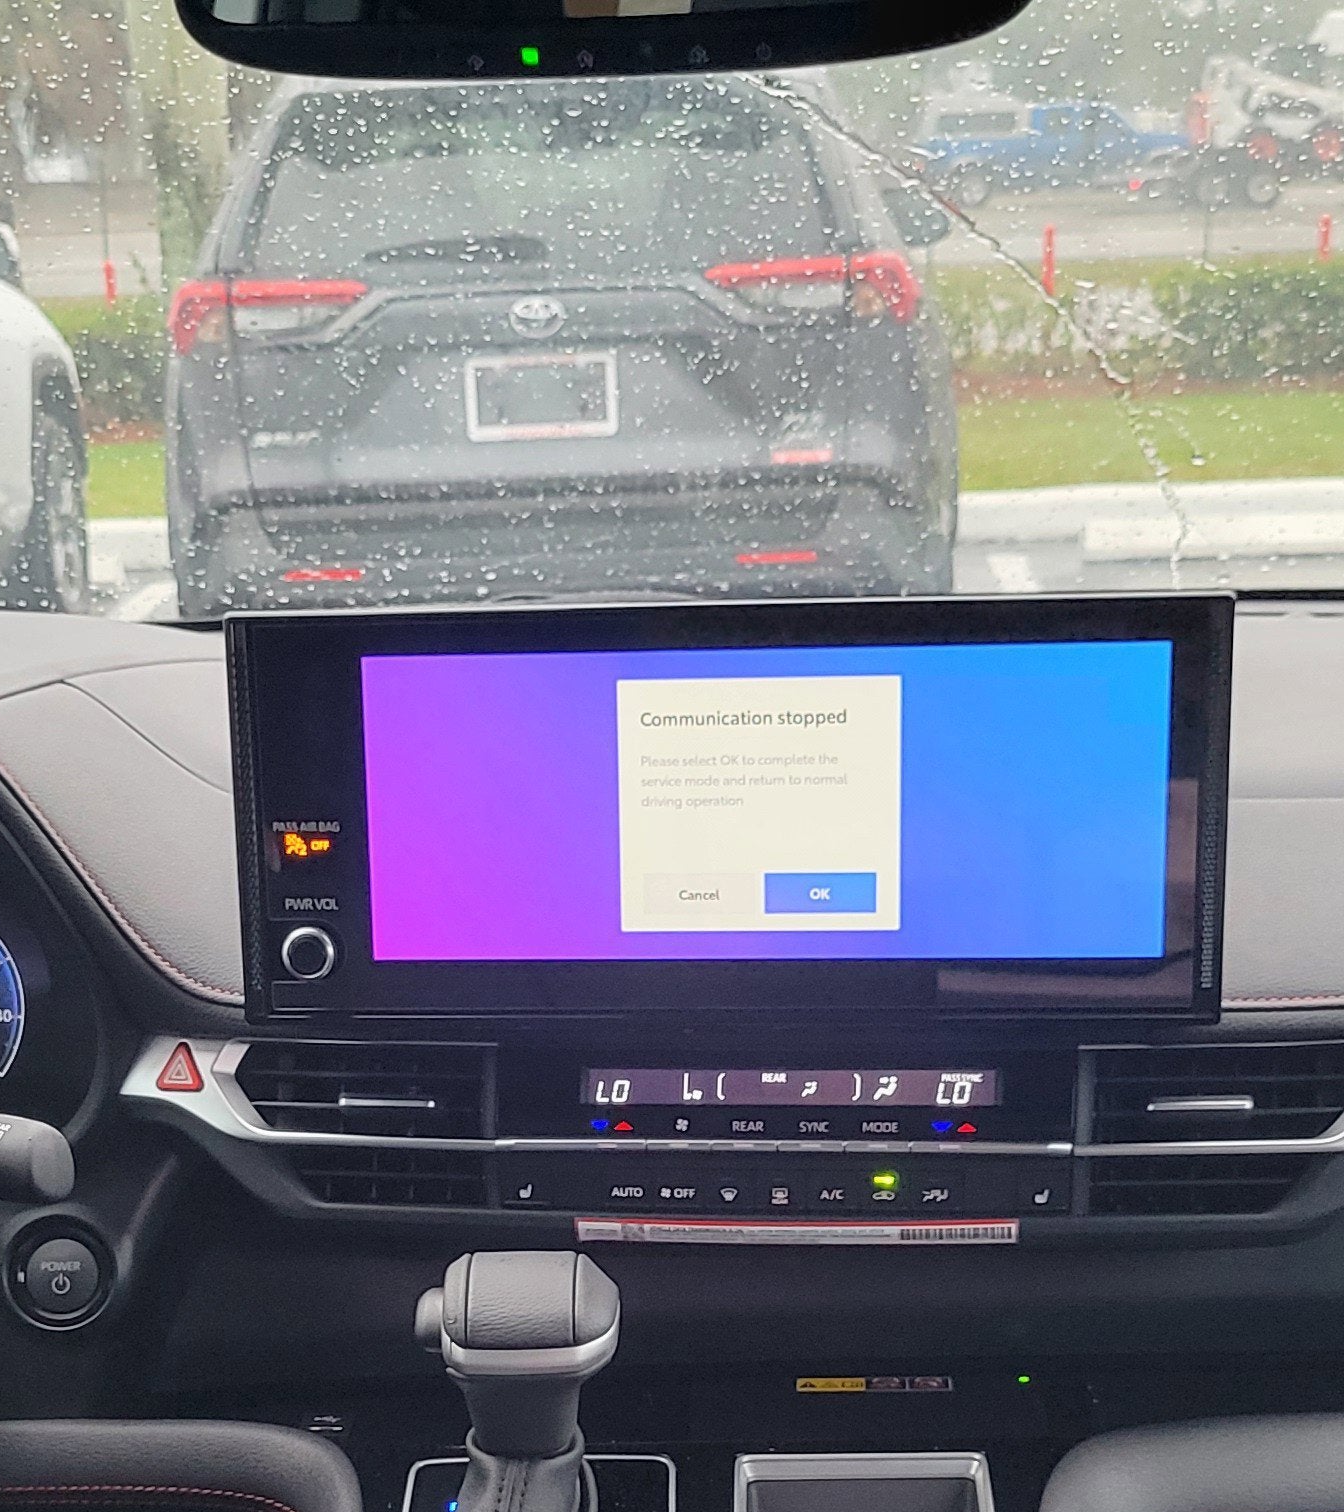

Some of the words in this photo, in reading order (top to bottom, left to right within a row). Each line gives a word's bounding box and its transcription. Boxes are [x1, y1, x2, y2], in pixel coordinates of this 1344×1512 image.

[640, 710, 773, 727] Communication
[777, 708, 848, 728] stopped
[640, 755, 680, 767] Please
[681, 755, 717, 767] select
[720, 755, 740, 767] OK
[742, 755, 755, 766] to
[758, 753, 816, 768] complete
[818, 753, 839, 765] the
[641, 776, 682, 788] service
[684, 775, 720, 787] mode
[723, 774, 746, 787] and
[748, 776, 785, 787] return
[788, 775, 802, 786] to
[804, 773, 848, 786] normal
[641, 795, 682, 810] driving
[685, 795, 744, 809] operation
[310, 839, 330, 852] OFF
[678, 889, 720, 901] Cancel
[809, 887, 831, 900] OK
[285, 898, 314, 911] PWR
[314, 898, 339, 911] VOL
[761, 1073, 787, 1083] REAR
[732, 1120, 765, 1133] REAR
[799, 1120, 830, 1133] SYNC
[862, 1120, 899, 1133] MODE
[611, 1187, 644, 1199] AUTO
[673, 1187, 696, 1199] OFF
[819, 1188, 844, 1201] A/C
[41, 1261, 81, 1272] POWER
